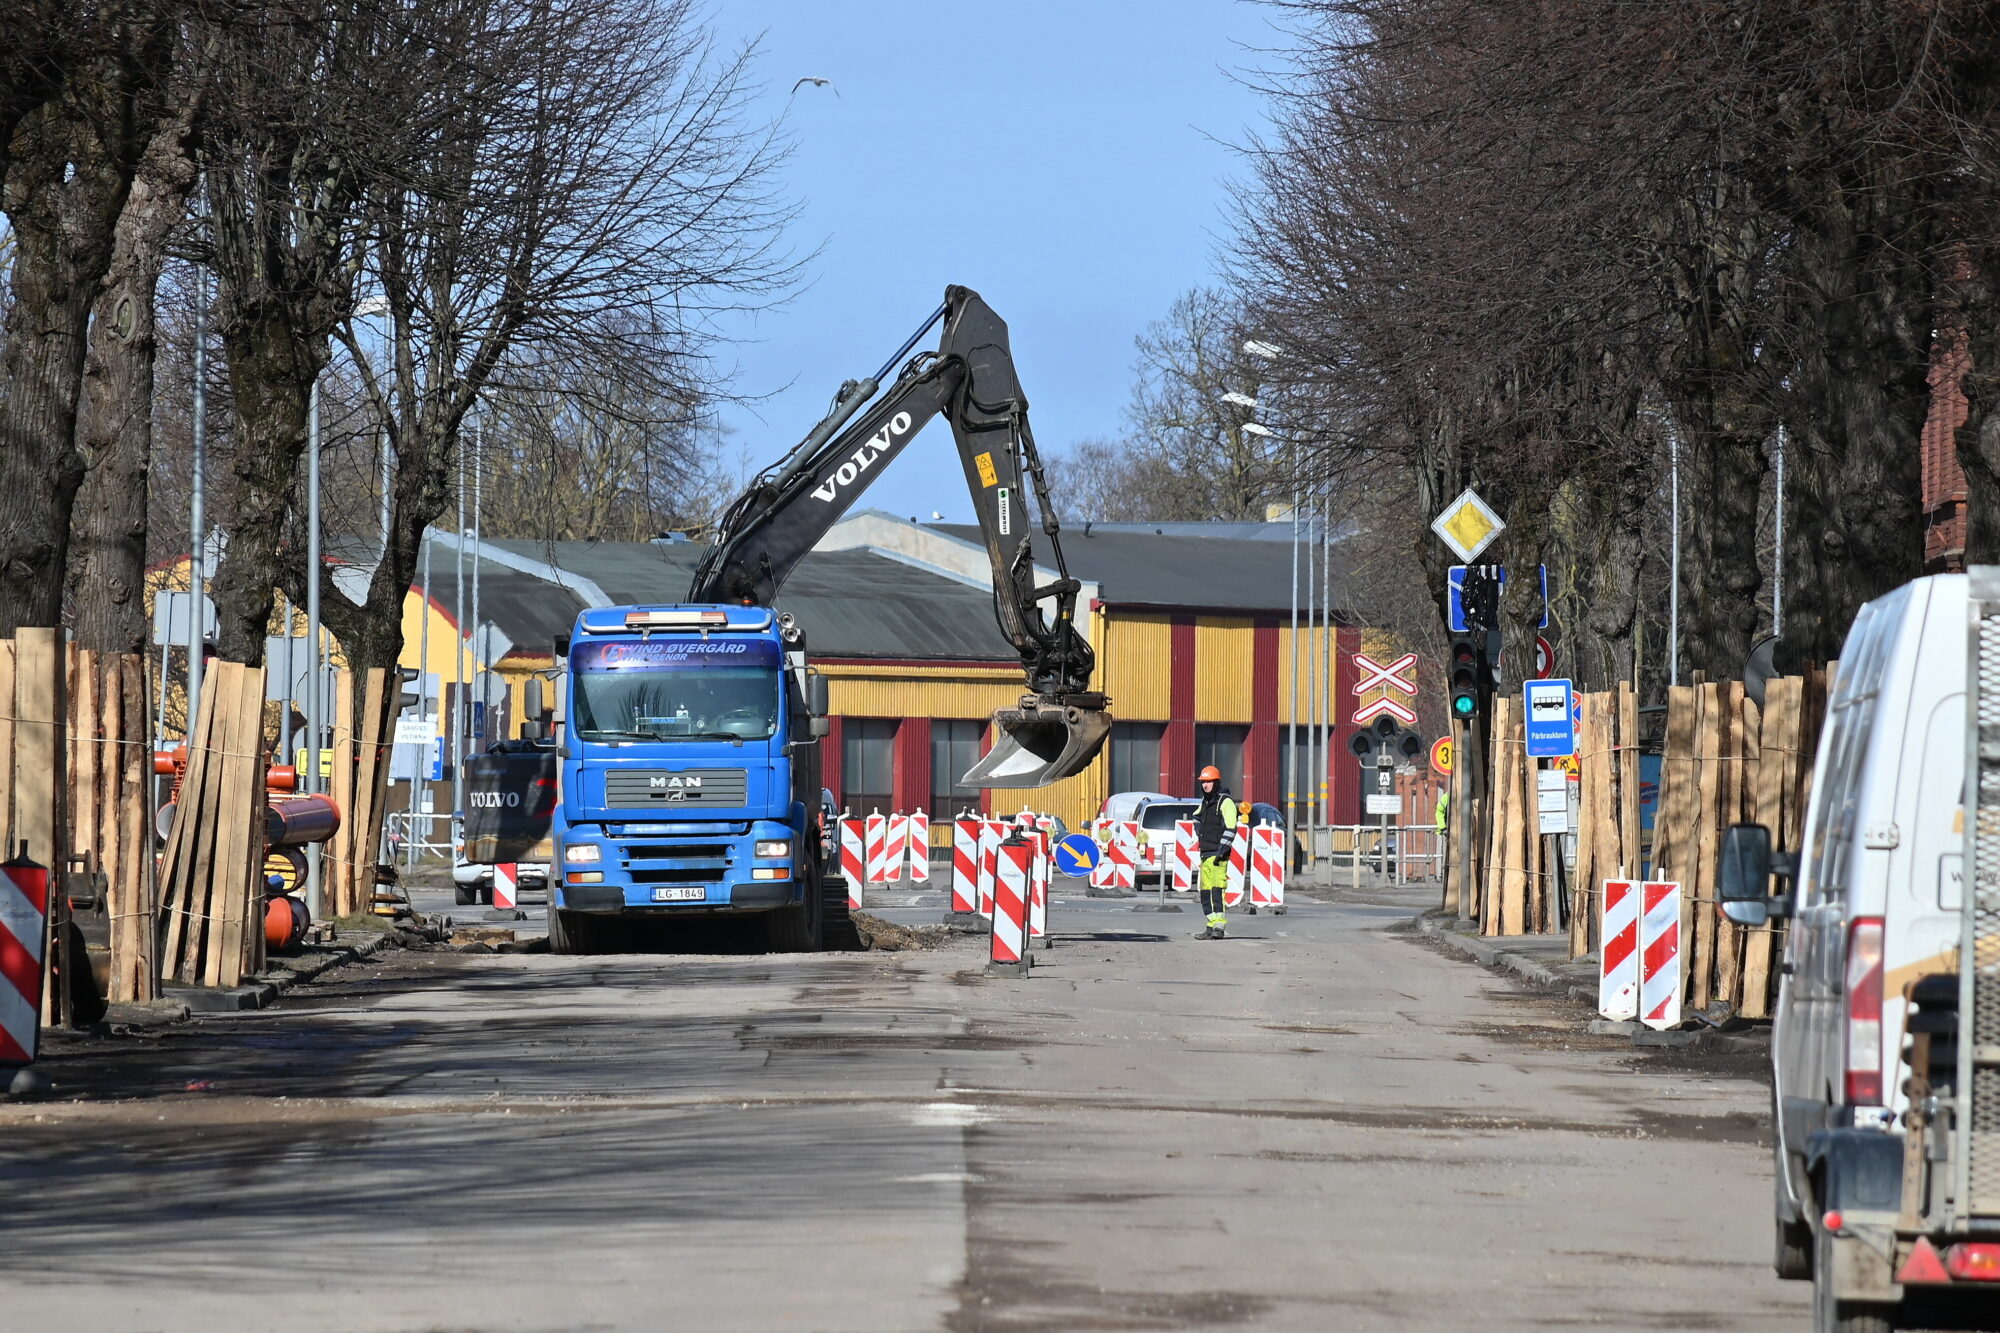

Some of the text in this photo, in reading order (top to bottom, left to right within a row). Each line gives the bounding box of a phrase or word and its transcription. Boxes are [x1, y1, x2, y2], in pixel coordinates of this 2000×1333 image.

[810, 411, 911, 502] VOLVO
[666, 641, 746, 654] ØVERGÅRD
[1441, 746, 1450, 765] 3
[650, 776, 701, 788] MAN
[1381, 773, 1389, 784] A
[470, 791, 520, 808] VOLVO
